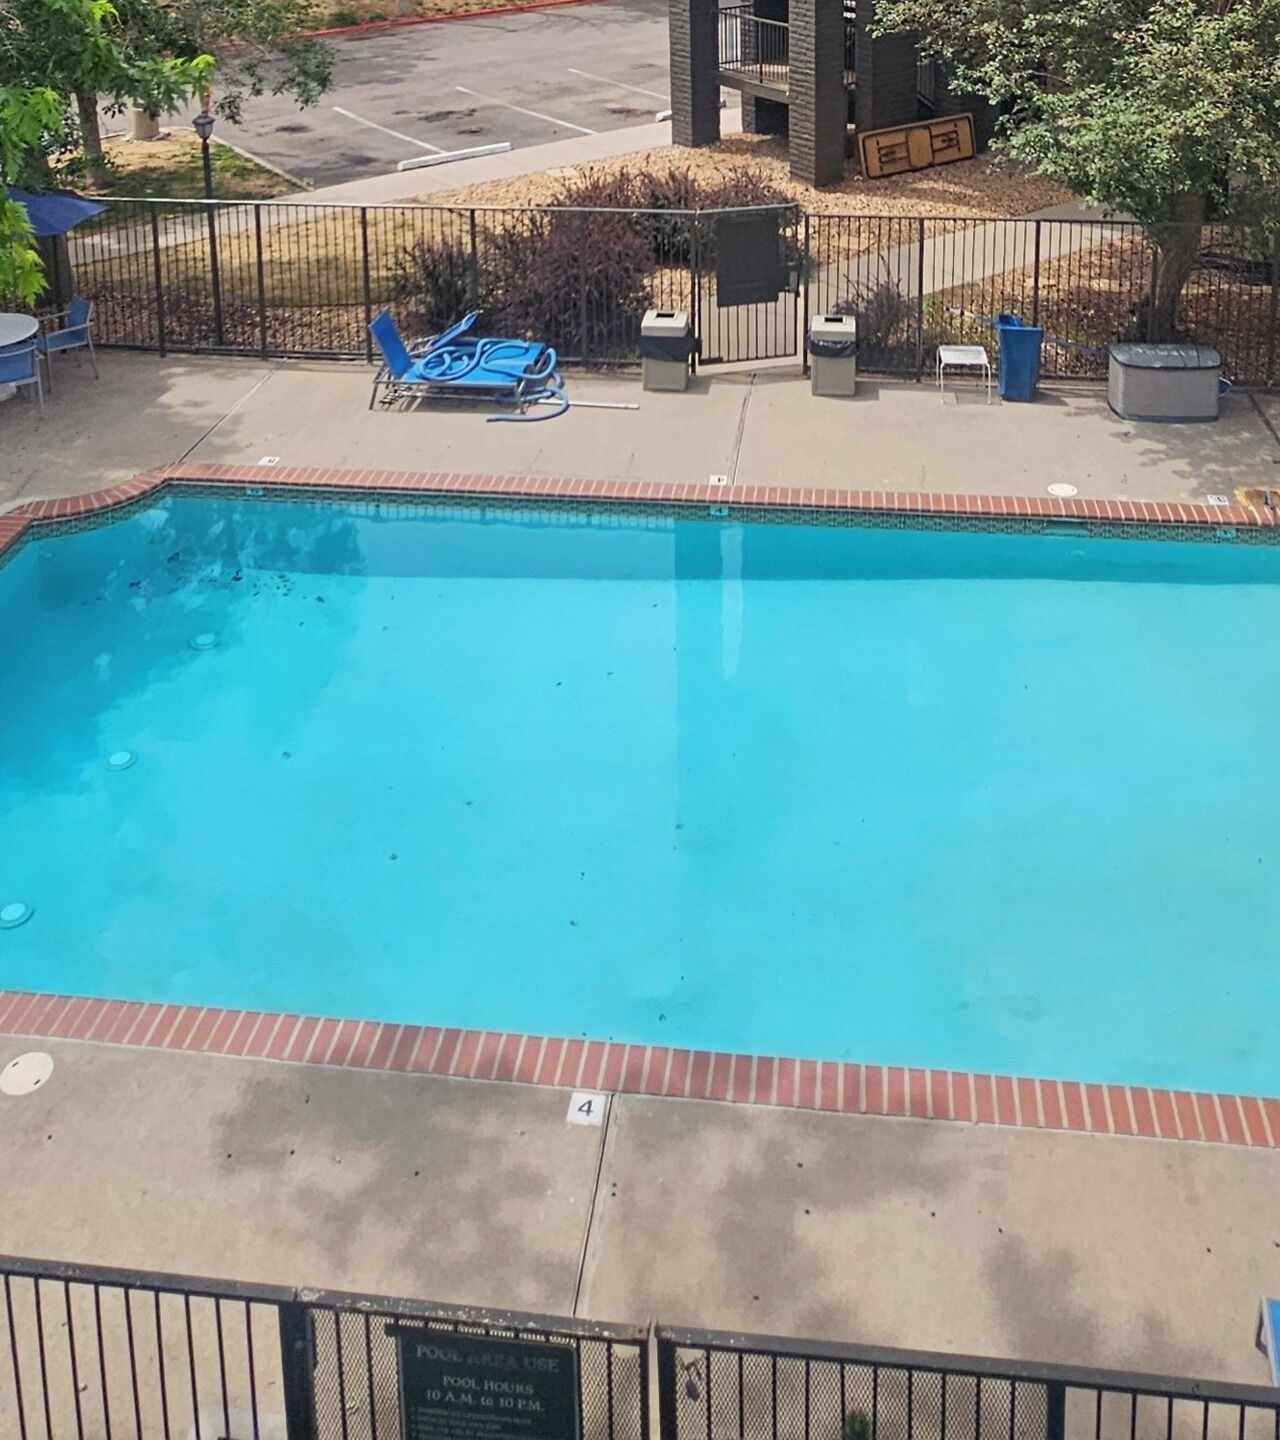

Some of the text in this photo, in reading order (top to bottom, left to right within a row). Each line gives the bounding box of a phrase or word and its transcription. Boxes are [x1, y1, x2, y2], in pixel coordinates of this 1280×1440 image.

[577, 1099, 594, 1117] 4
[416, 1344, 560, 1373] POOL AREA USE
[442, 1375, 535, 1396] POOL HOURS
[426, 1389, 441, 1402] 10
[481, 1397, 494, 1407] to
[500, 1397, 515, 1409] 10
